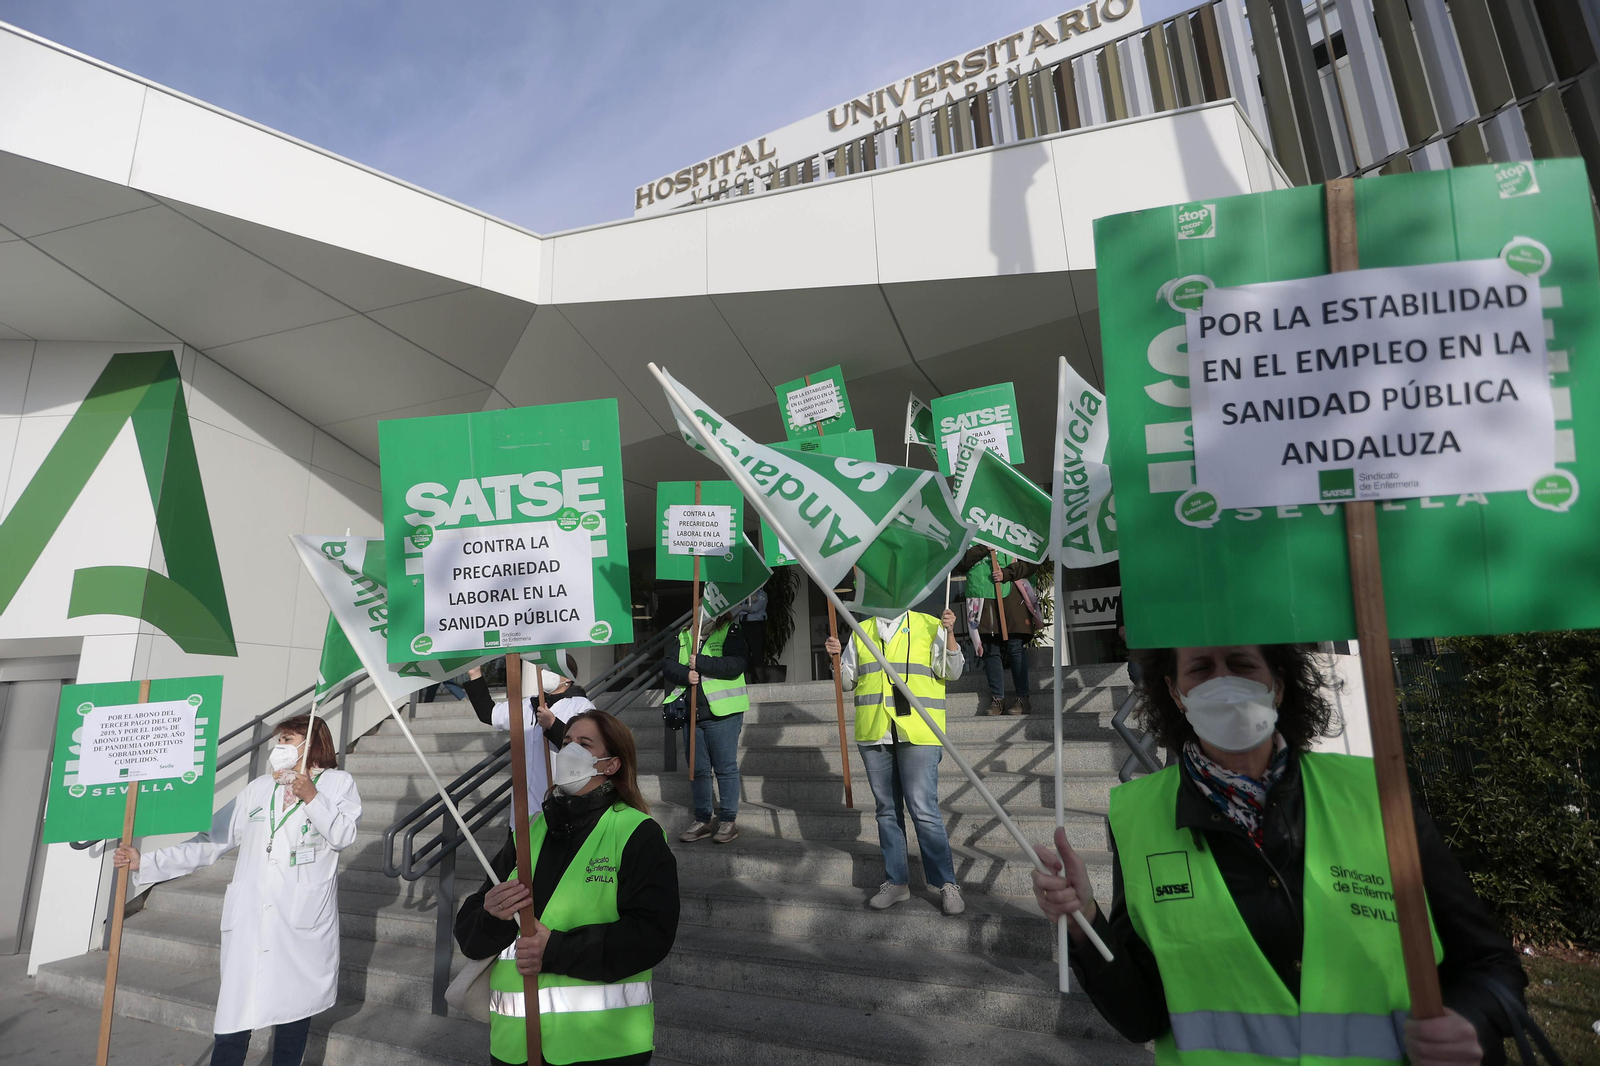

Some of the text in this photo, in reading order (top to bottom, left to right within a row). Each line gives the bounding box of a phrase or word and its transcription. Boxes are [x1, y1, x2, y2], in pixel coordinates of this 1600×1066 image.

[635, 0, 1135, 209] HOSPITAL UNIVERSITARIO
[1495, 165, 1526, 182] stop
[1179, 208, 1208, 223] stop
[1199, 283, 1528, 339] POR LA ESTABILIDAD
[1203, 330, 1531, 383] EN EL EMPLEO EN LA
[804, 383, 833, 395] ESTABILIDAD
[795, 398, 834, 414] SANIDAD PÚBLICA
[803, 394, 821, 404] EMPLEO
[1221, 378, 1519, 426] SANIDAD PÚBLICA
[804, 407, 828, 418] ANDALUZA
[940, 404, 1012, 433] SATSE
[1280, 430, 1461, 466] ANDALUZA
[1359, 472, 1399, 481] Sindicato
[1322, 488, 1353, 498] SATSE
[1359, 483, 1371, 491] de
[403, 466, 606, 527] SATSE
[1190, 499, 1202, 507] Soy
[965, 506, 1044, 553] SATSE
[463, 535, 549, 555] CONTRA LA
[453, 559, 561, 581] PRECARIEDAD
[449, 584, 567, 606] LABORAL EN LA
[438, 608, 580, 632] SANIDAD PÚBLICA
[134, 711, 160, 719] ABONO
[100, 721, 129, 729] TERCER
[93, 737, 119, 745] ABONO
[170, 730, 185, 738] AÑO
[105, 743, 142, 751] PANDEMIA
[143, 739, 184, 748] OBJETIVOS
[108, 748, 168, 758] SOBRADAMENTE
[114, 756, 159, 765] CUMPLIDOS.
[91, 783, 174, 796] SEVLLA
[585, 875, 614, 884] SEVILLA
[1330, 866, 1385, 886] Sindicato
[1155, 882, 1190, 897] SATSE
[1333, 881, 1350, 893] de
[1350, 903, 1399, 923] SEVILL
